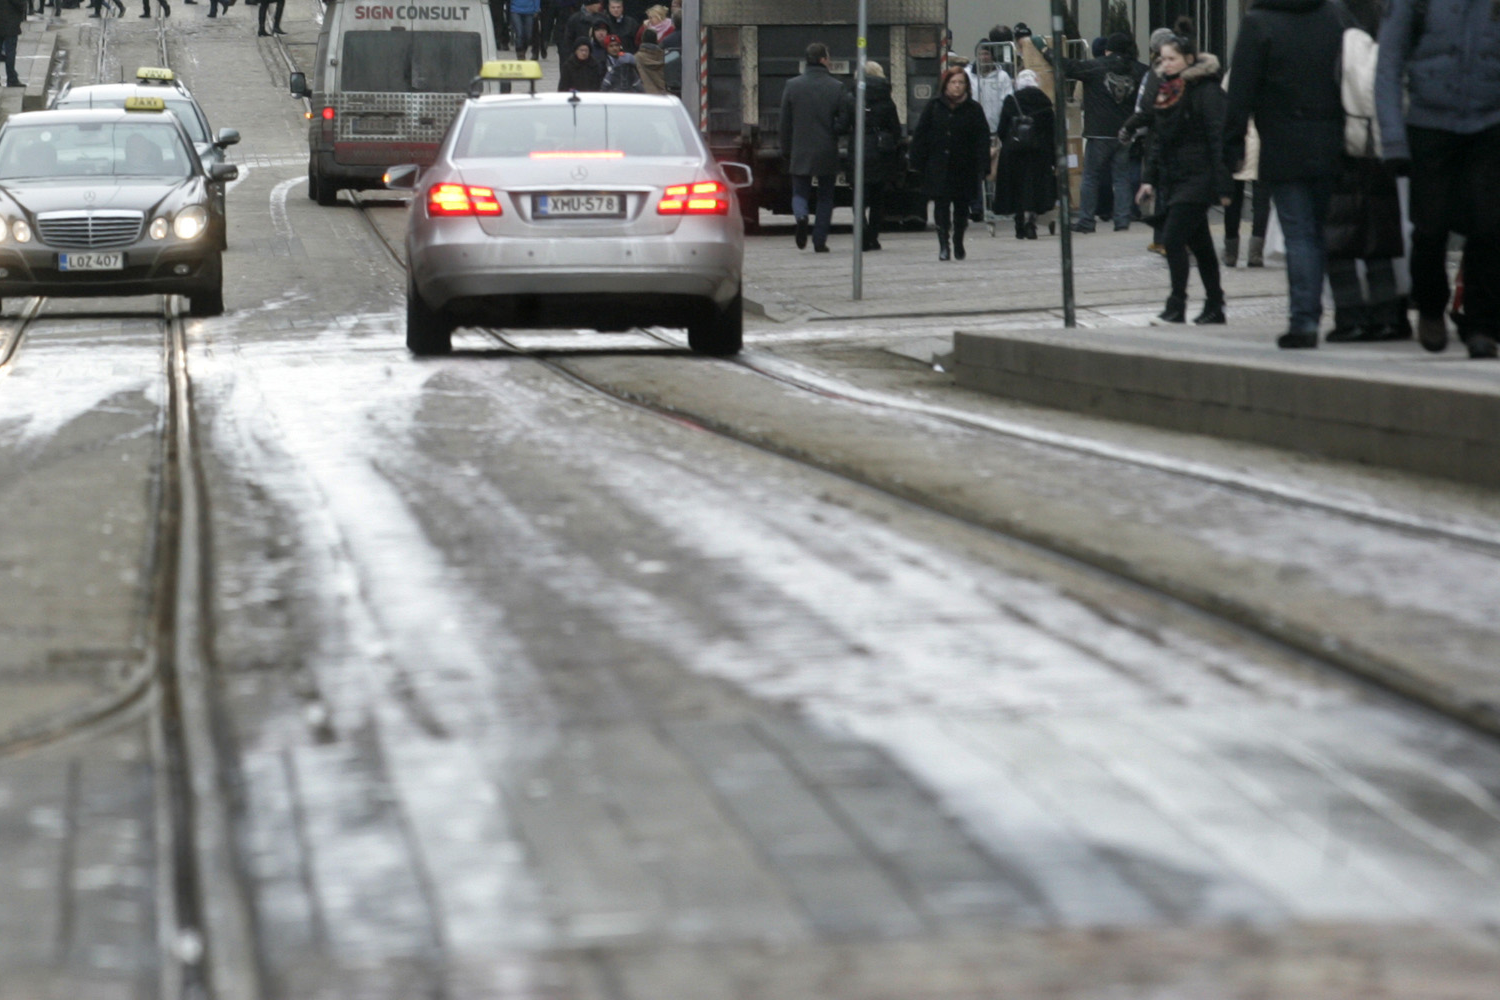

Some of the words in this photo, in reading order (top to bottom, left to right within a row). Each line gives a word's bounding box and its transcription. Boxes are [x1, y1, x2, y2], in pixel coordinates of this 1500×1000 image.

[355, 6, 393, 19] SIGN
[396, 6, 470, 20] CONSULT
[551, 197, 614, 212] XMU-578
